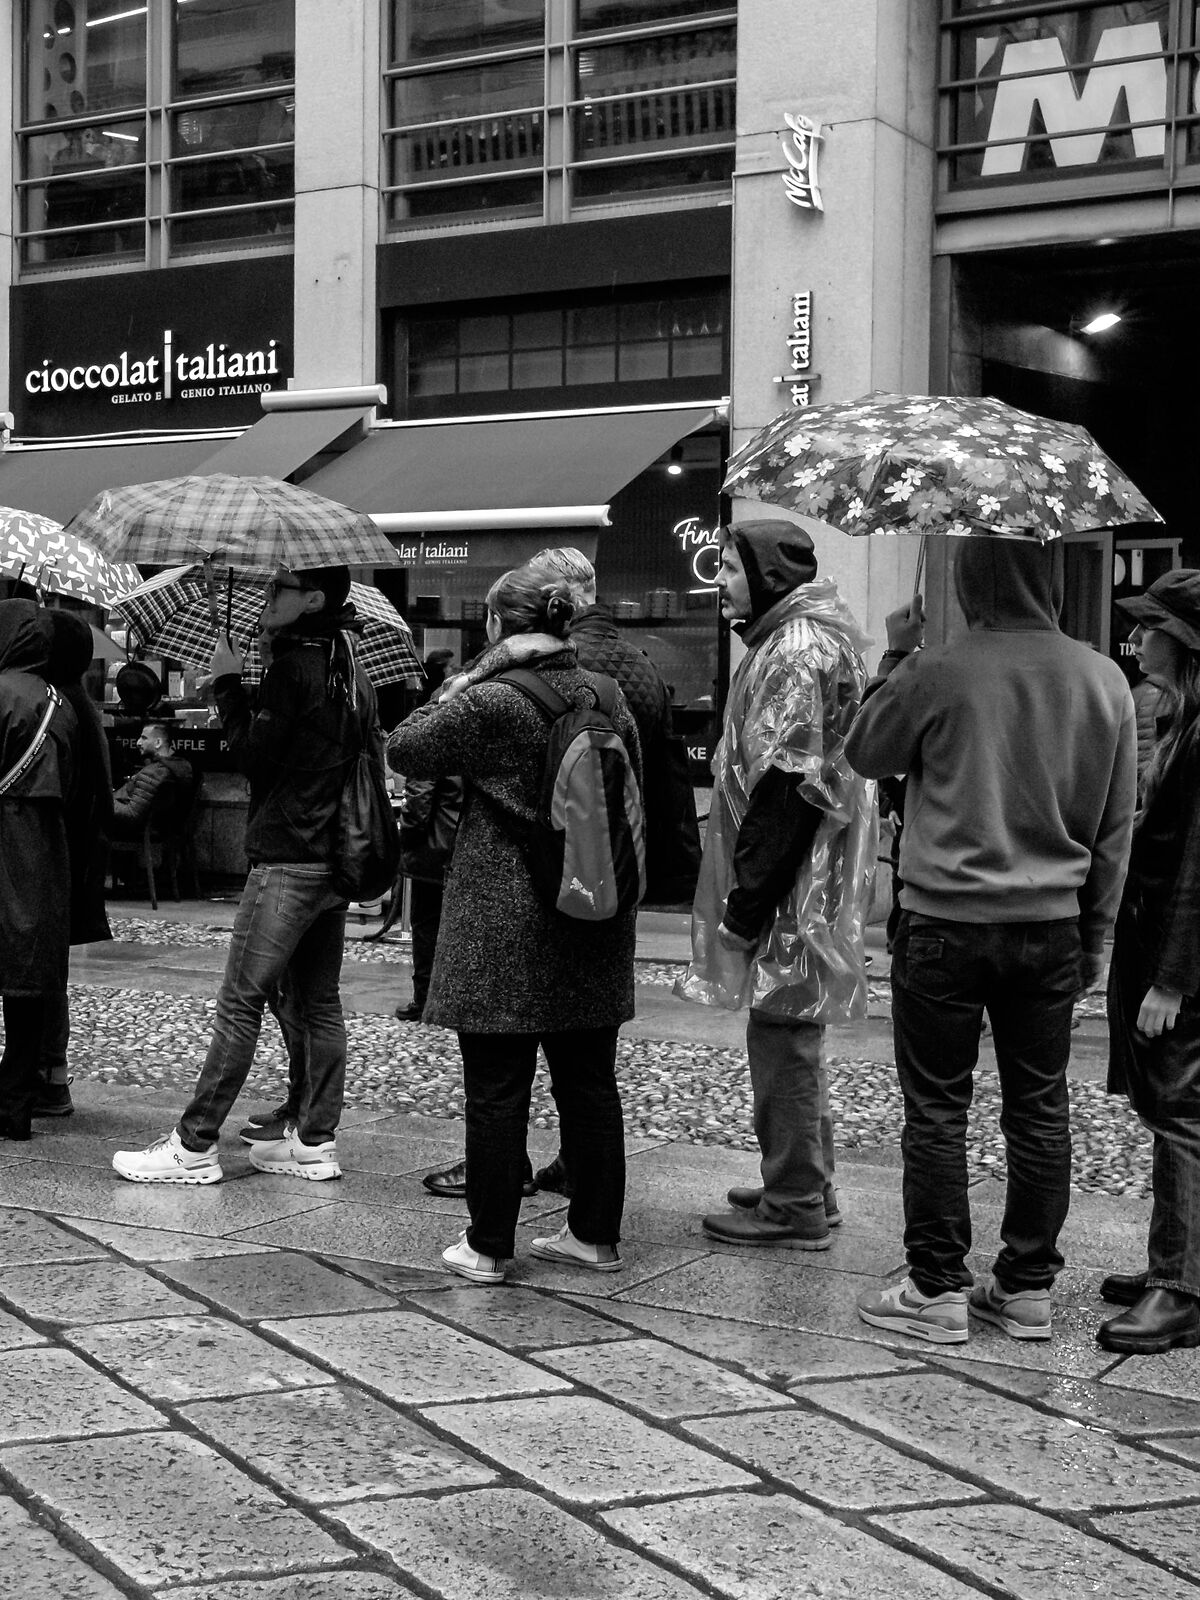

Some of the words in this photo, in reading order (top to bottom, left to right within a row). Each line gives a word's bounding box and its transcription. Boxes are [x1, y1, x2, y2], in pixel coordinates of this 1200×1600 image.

[111, 392, 152, 404] GELATO
[155, 391, 162, 401] E
[181, 387, 215, 399] GENIO
[218, 383, 272, 397] ITALIANO
[170, 739, 206, 751] AFFLE
[686, 746, 707, 760] KE
